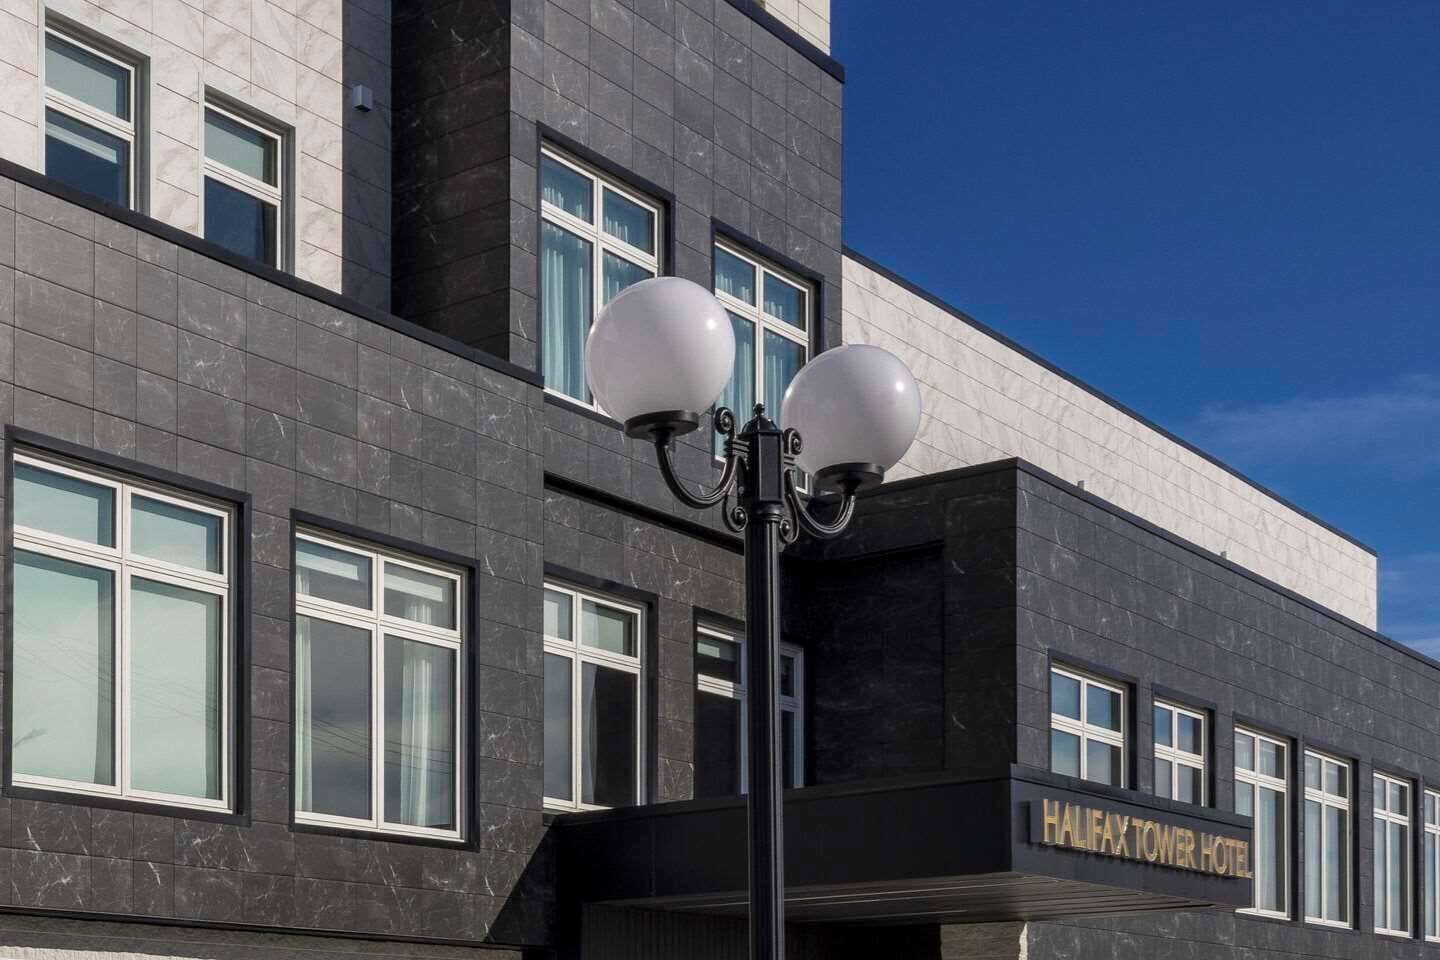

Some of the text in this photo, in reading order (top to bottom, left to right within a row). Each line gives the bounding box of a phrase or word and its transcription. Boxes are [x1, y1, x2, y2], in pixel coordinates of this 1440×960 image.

[1043, 799, 1254, 879] HALIFAX TOWER HOTEL
